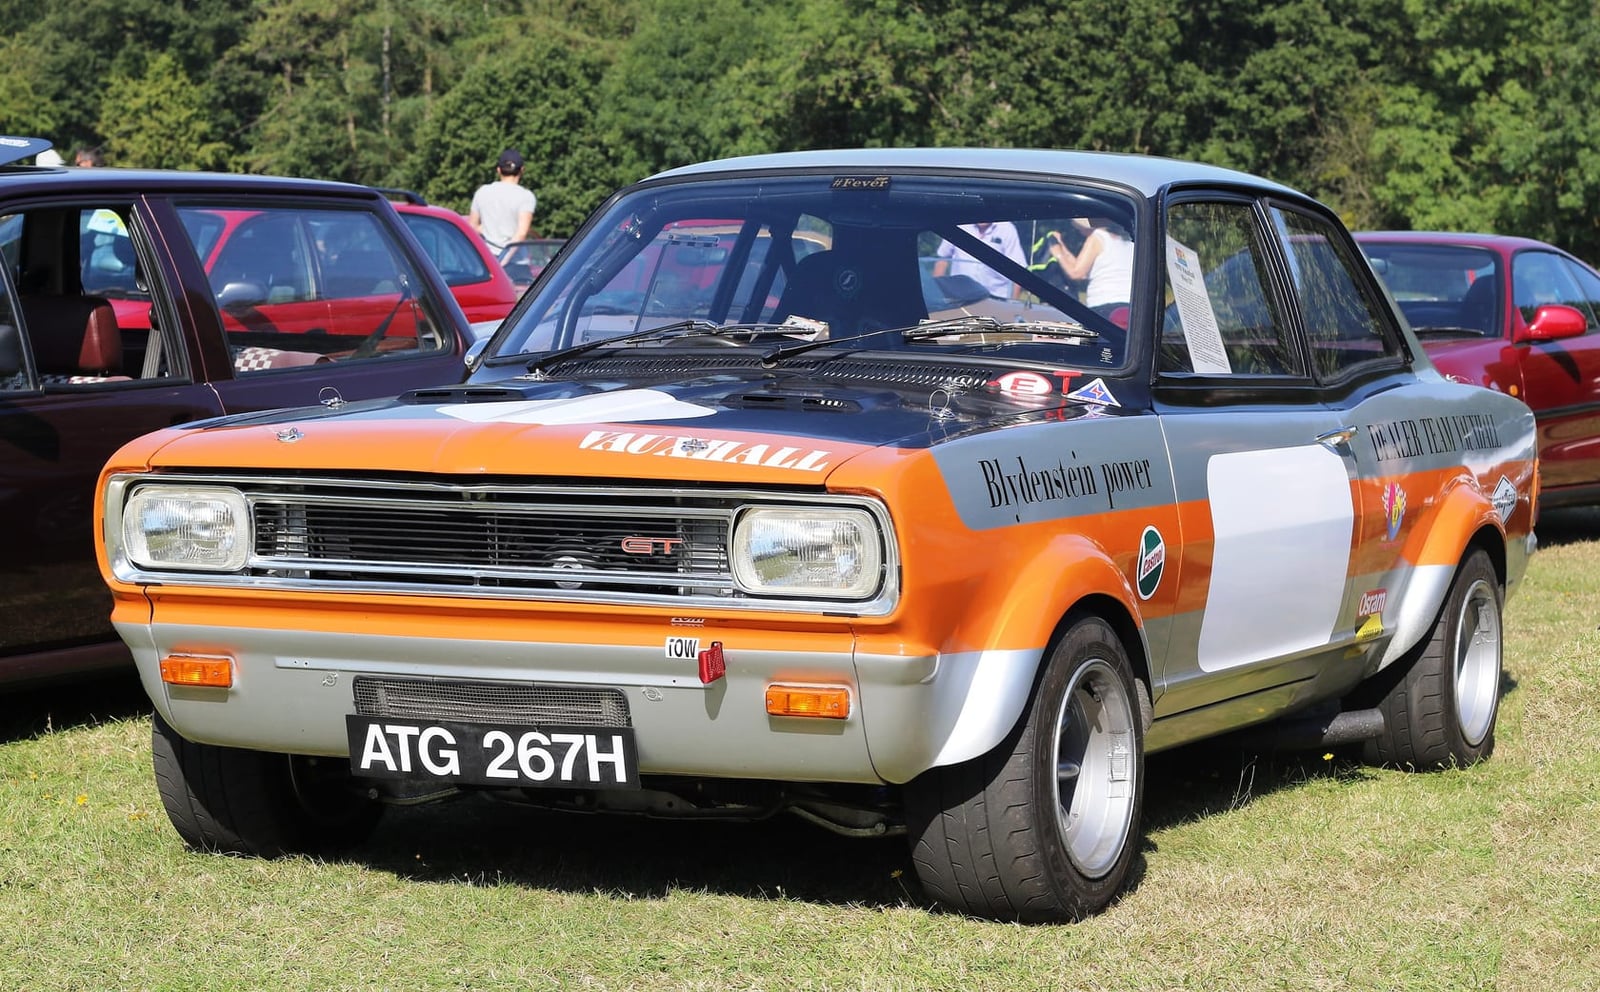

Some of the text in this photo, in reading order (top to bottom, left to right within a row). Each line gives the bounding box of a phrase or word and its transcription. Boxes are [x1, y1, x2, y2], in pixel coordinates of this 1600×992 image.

[832, 177, 889, 188] #Fever
[1009, 377, 1038, 393] E
[1420, 416, 1458, 454] TEAM
[978, 450, 1153, 523] Blydenstein power
[622, 536, 682, 555] GT
[1358, 592, 1387, 616] Osram
[668, 638, 698, 658] TOW
[360, 723, 627, 783] ATG 267H
